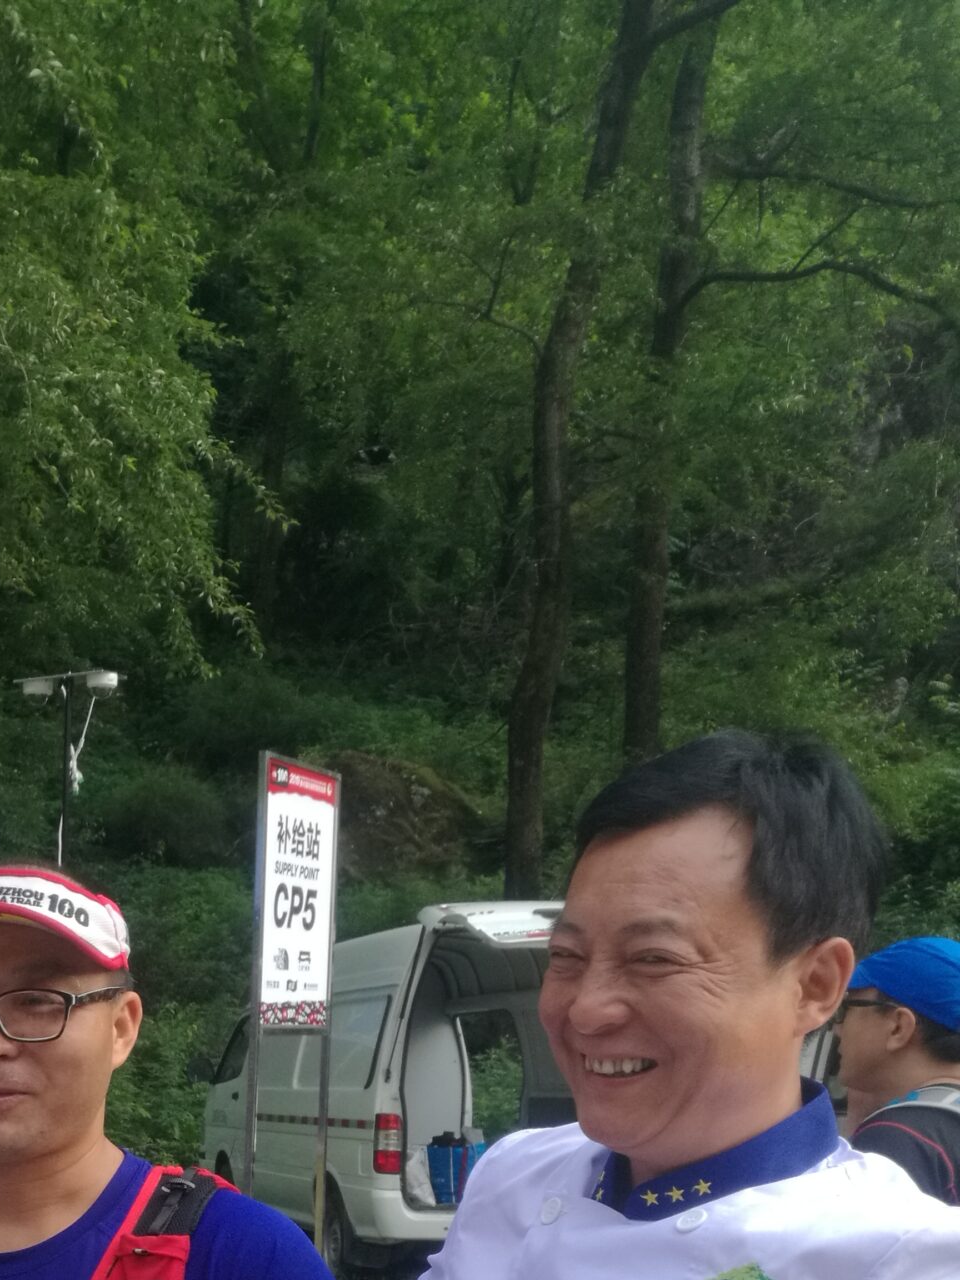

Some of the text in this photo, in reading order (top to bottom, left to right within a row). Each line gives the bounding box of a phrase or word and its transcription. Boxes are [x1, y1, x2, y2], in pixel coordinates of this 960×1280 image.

[277, 814, 321, 861] 补给站
[274, 860, 320, 881] SUPPLY POINT
[10, 896, 42, 907] TRAIL
[47, 893, 90, 928] 100
[273, 882, 318, 931] CP5
